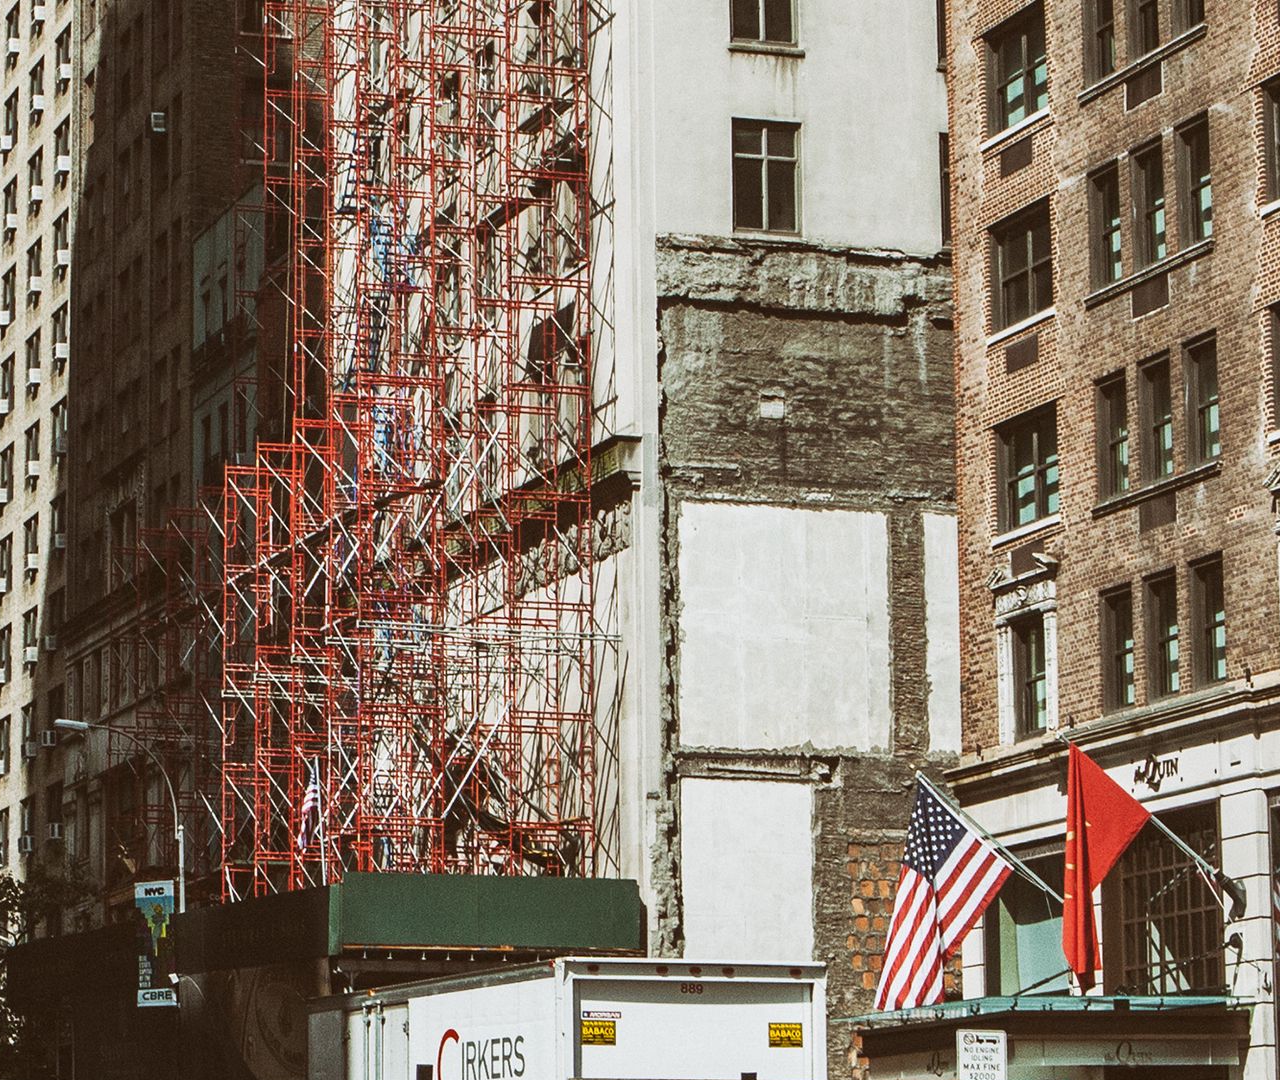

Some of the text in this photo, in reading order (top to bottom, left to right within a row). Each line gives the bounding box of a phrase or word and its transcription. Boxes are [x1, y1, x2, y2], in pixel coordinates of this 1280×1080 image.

[144, 887, 165, 896] NYC
[680, 983, 703, 994] 889
[142, 991, 173, 1000] CBRE
[582, 1026, 615, 1035] BABACO
[770, 1030, 801, 1038] BABACO
